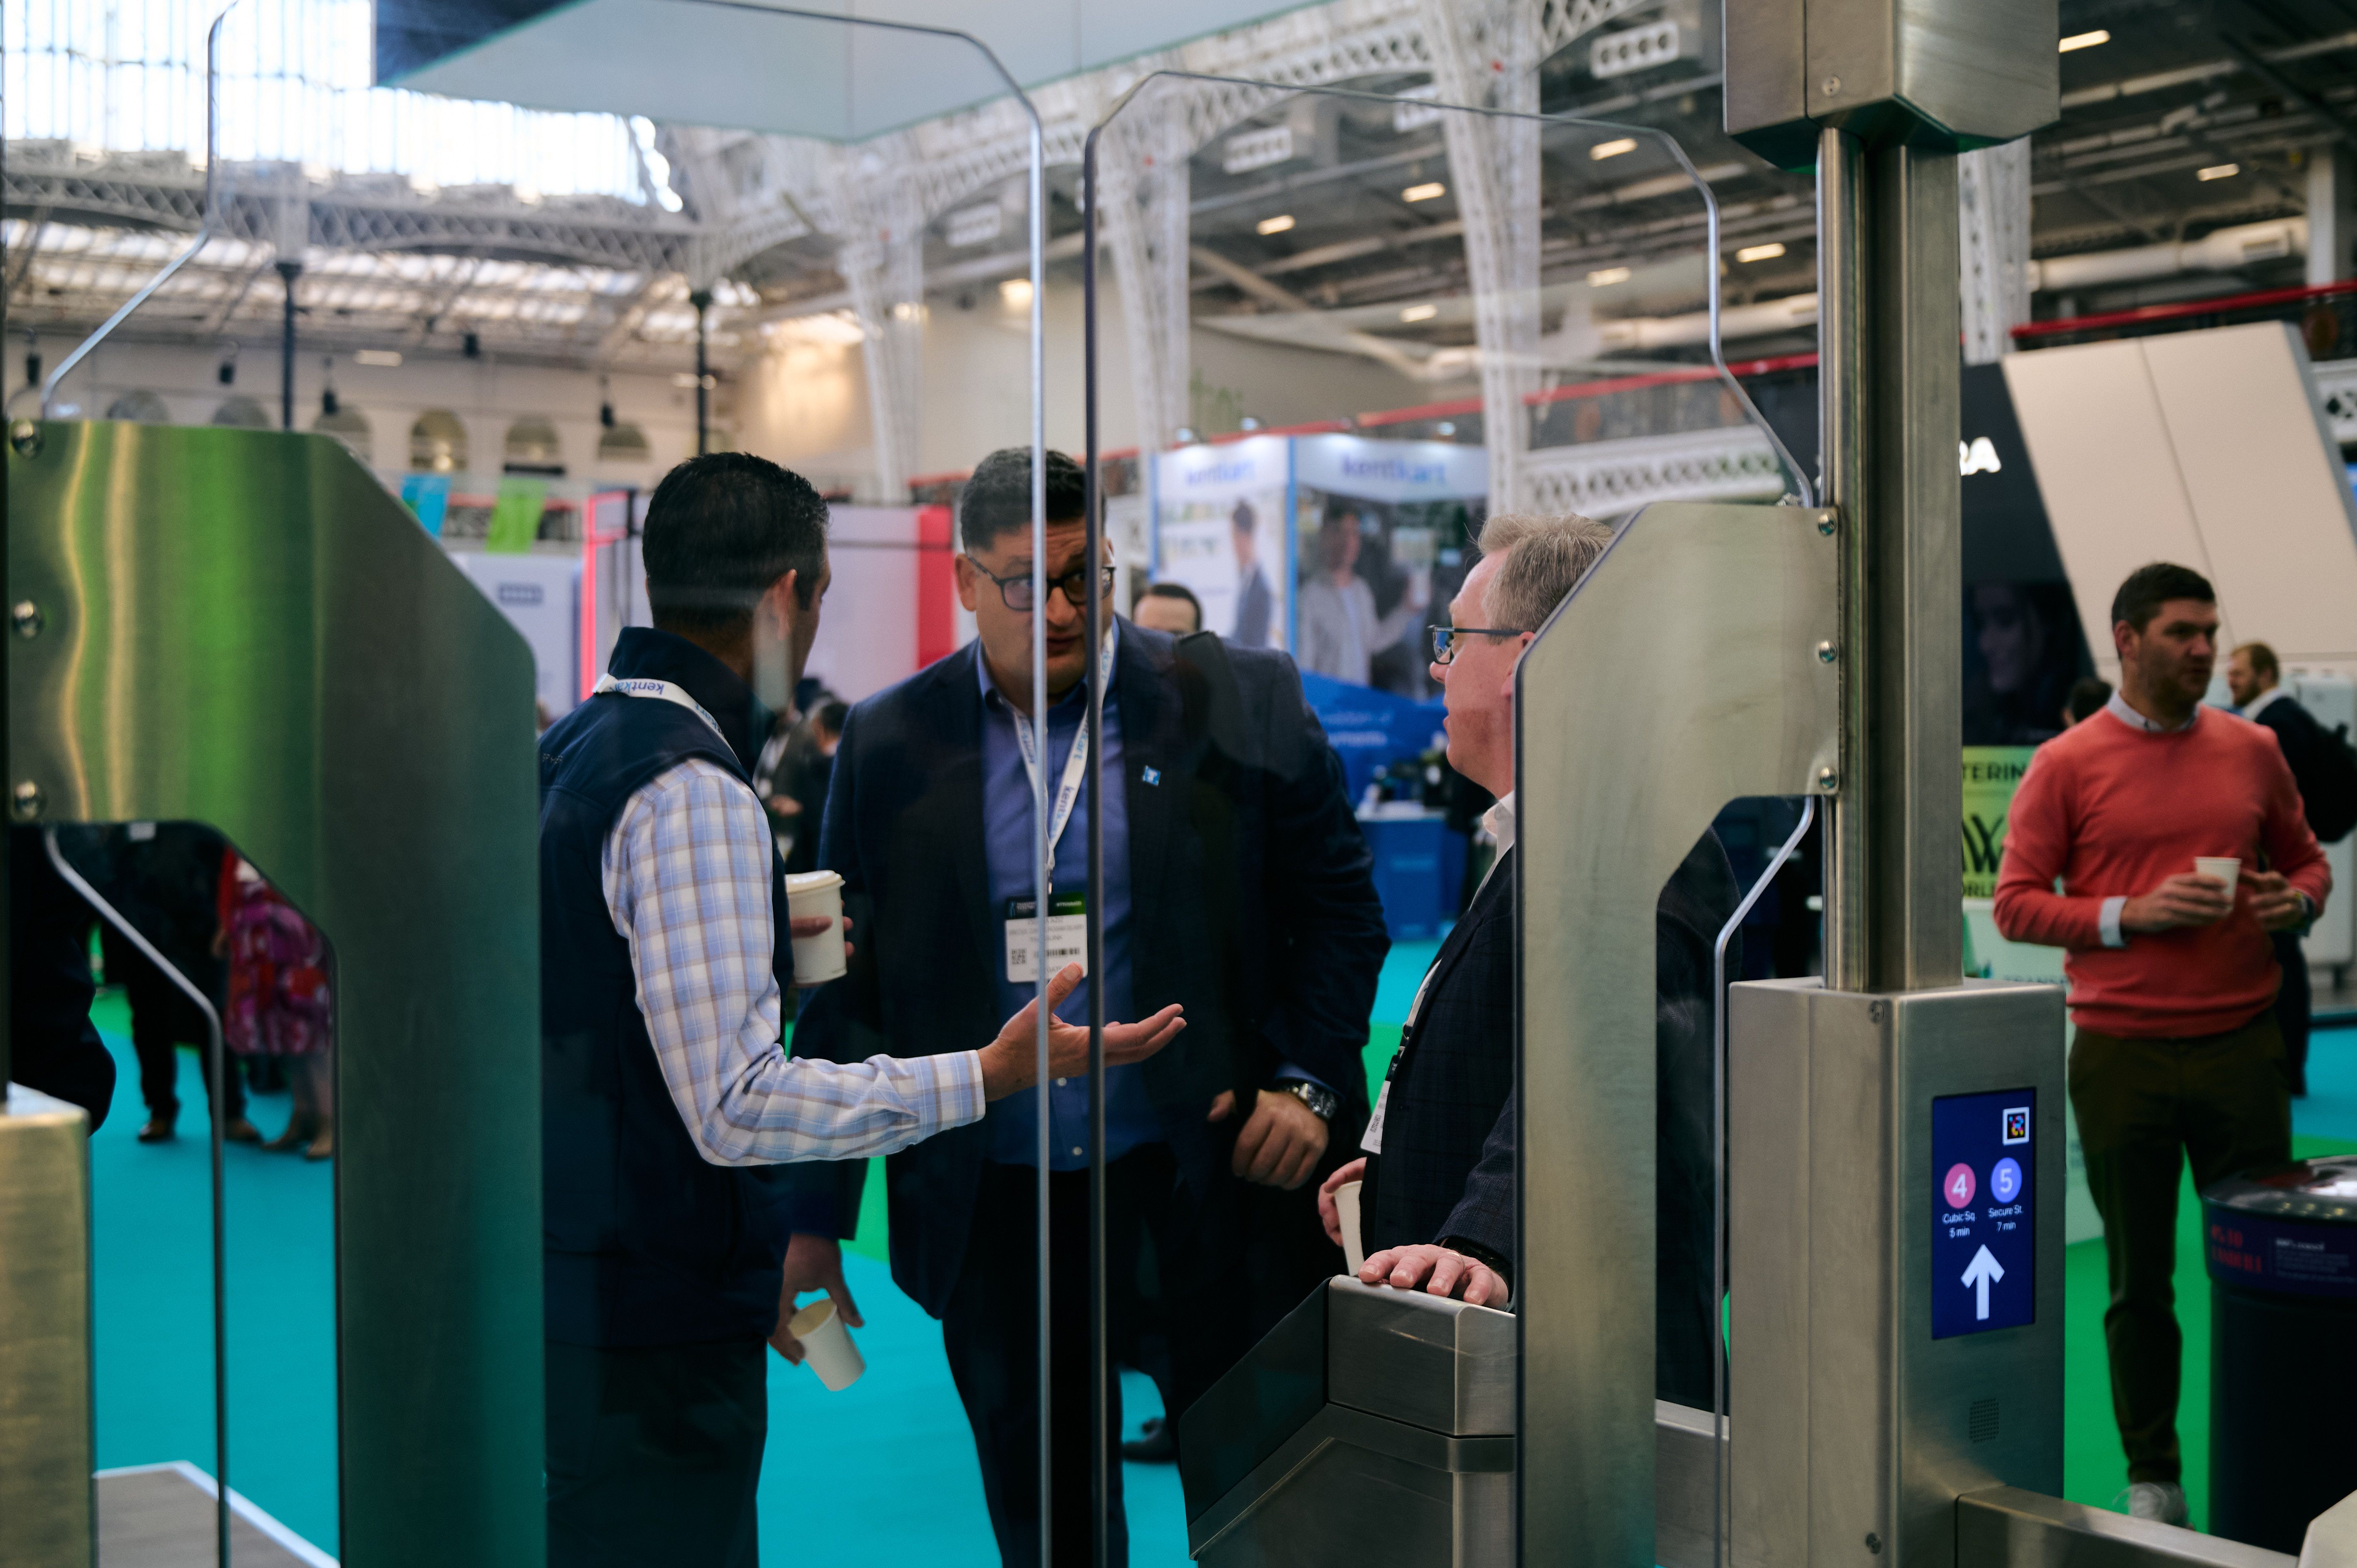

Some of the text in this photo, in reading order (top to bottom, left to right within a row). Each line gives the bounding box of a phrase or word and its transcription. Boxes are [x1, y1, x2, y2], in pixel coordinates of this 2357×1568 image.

[1952, 1173, 1968, 1199] 4
[1999, 1168, 2013, 1194] 5
[1988, 1207, 2013, 1218] Secure
[1942, 1213, 1964, 1224] Cubic
[1956, 1227, 1970, 1237] min
[1997, 1221, 2016, 1232] 7 min
